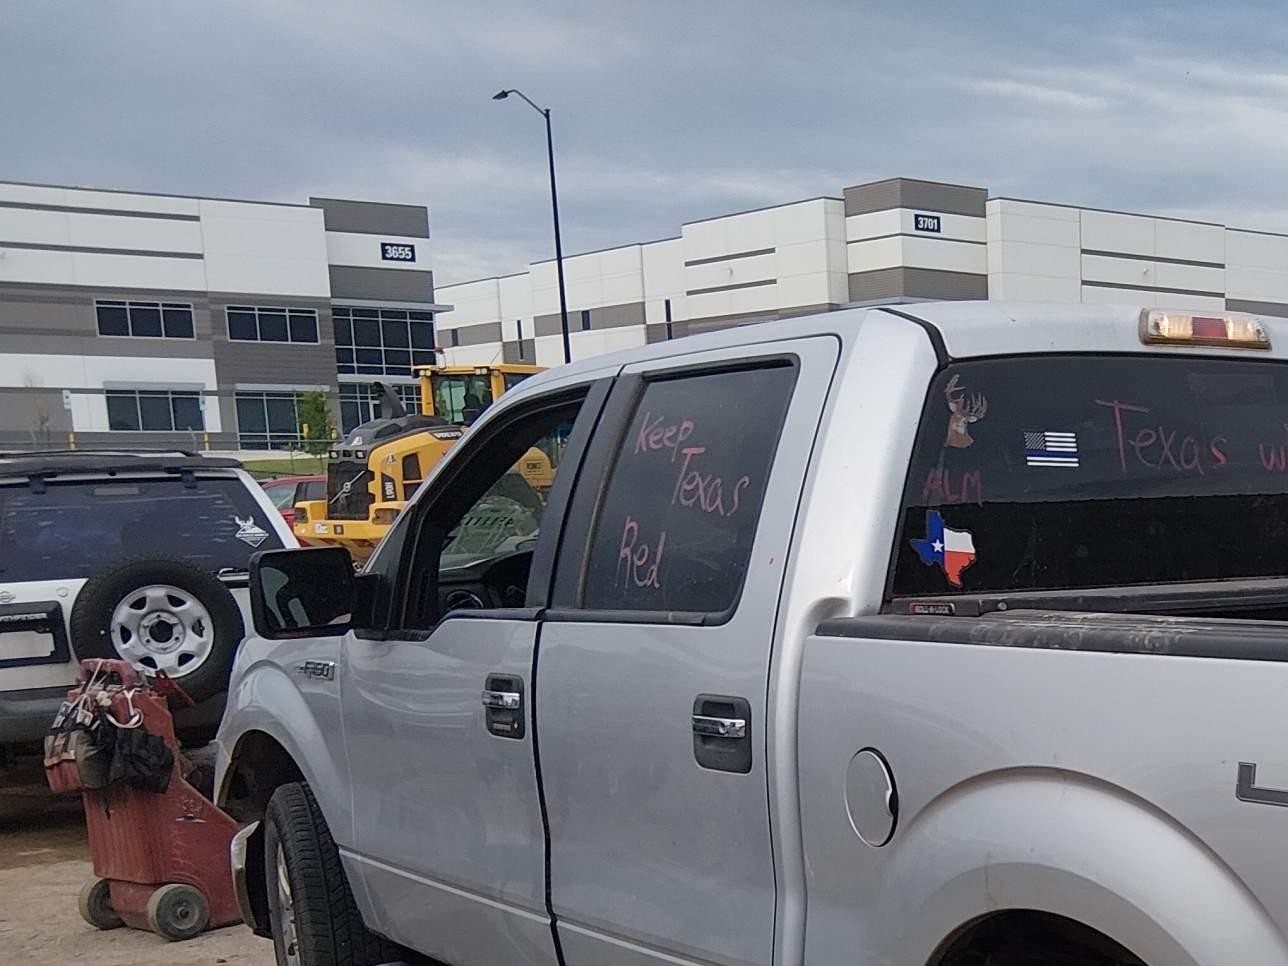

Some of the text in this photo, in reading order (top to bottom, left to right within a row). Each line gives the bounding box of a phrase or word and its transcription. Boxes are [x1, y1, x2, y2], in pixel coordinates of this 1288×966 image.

[385, 246, 412, 259] 3655
[917, 217, 938, 230] 3701
[635, 412, 694, 462] Keep
[1095, 400, 1227, 475] Texas
[672, 447, 749, 516] Texas
[614, 516, 666, 589] Red
